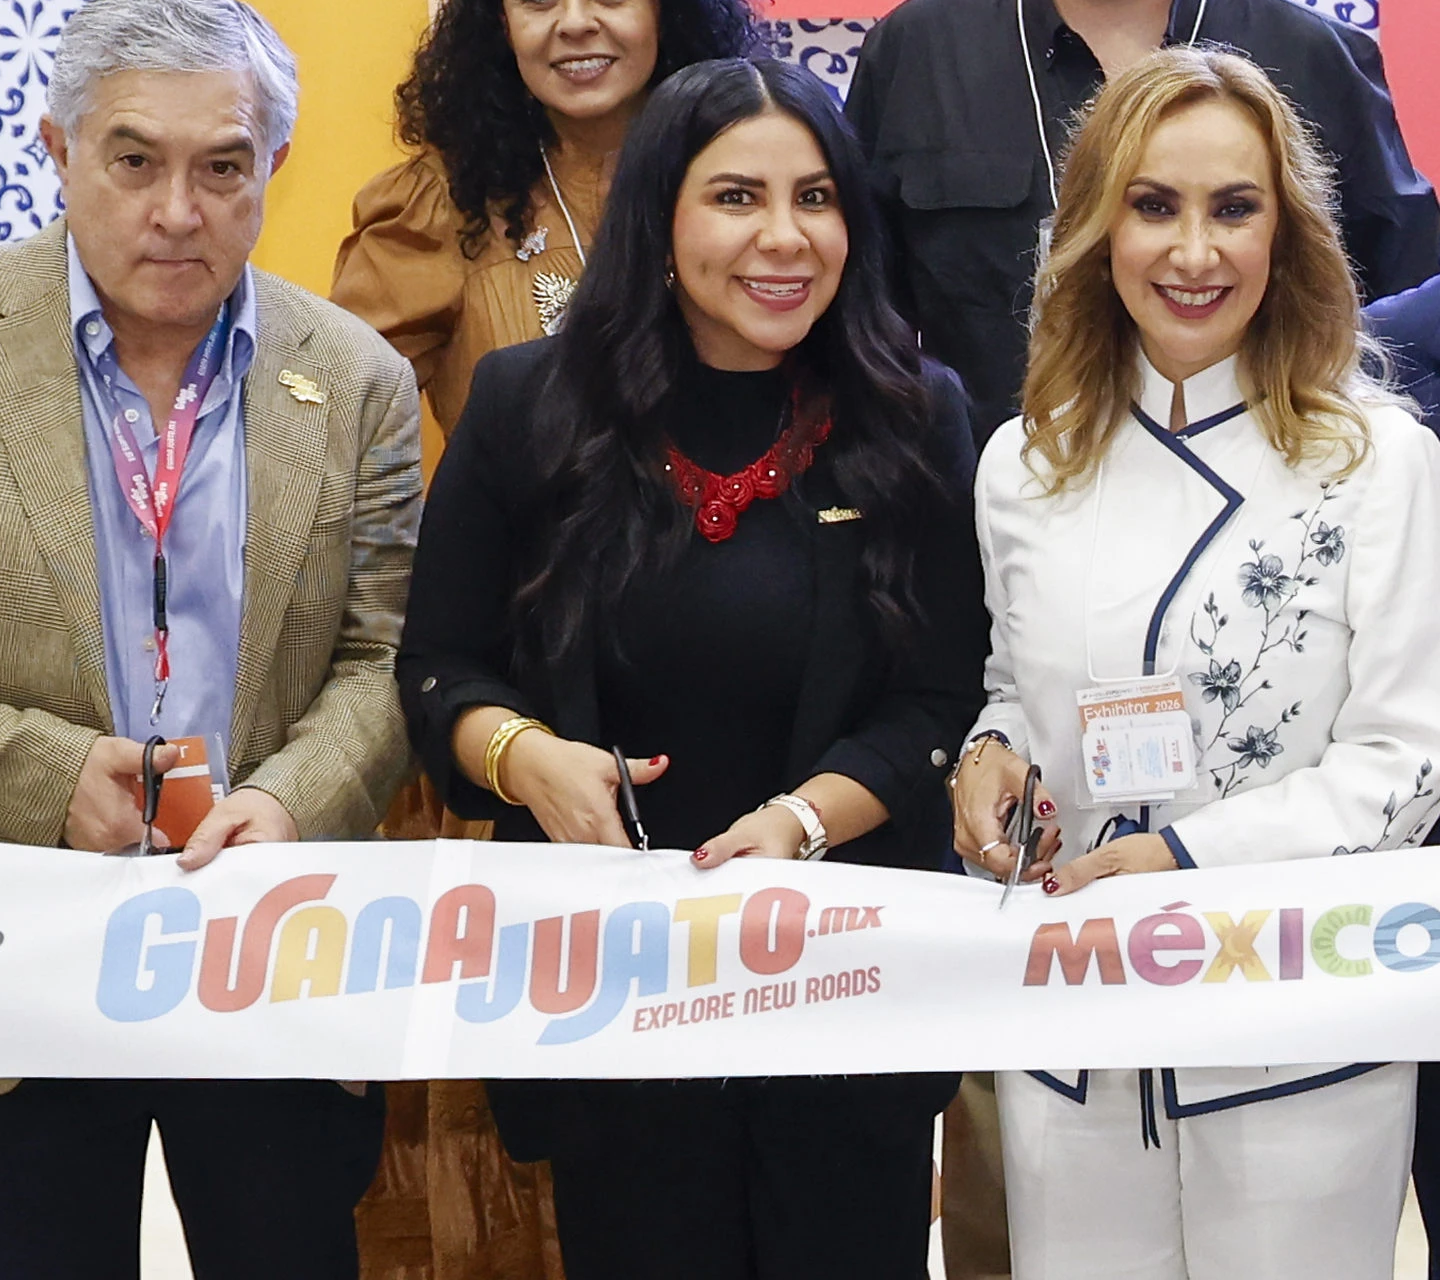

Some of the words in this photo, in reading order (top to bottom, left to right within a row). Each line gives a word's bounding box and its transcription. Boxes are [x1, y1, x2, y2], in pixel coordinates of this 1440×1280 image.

[1083, 701, 1150, 721] Exhibitor
[1155, 699, 1181, 712] 2026
[632, 991, 736, 1033] EXPLORE
[743, 980, 797, 1015] NEW
[805, 965, 881, 1004] ROADS
